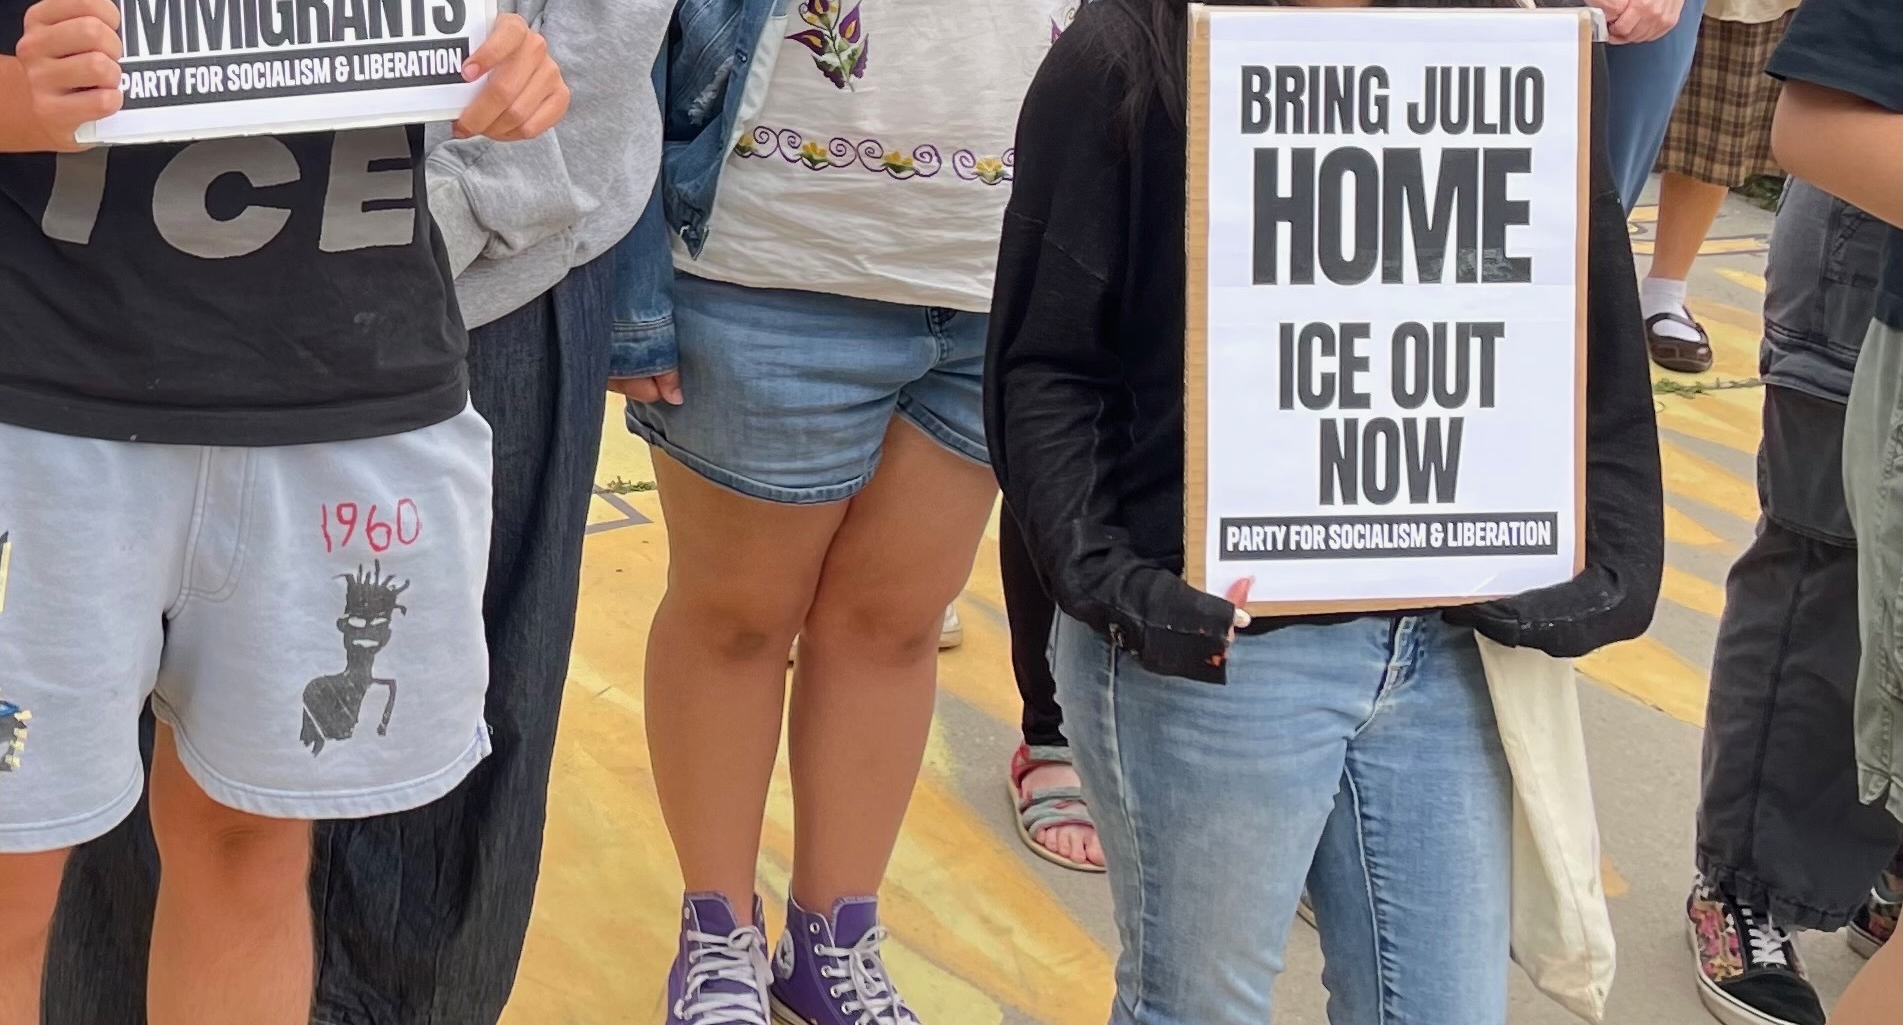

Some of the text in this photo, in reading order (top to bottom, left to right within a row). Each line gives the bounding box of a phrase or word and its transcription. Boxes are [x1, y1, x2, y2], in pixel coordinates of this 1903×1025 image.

[120, 47, 462, 99] PARTY FOR SOCIALISM & LIBERATION
[1241, 66, 1544, 135] BRING JULIO
[42, 125, 415, 259] ICE
[1253, 147, 1531, 285] HOME
[1280, 322, 1504, 410] ICE OUT
[1320, 417, 1464, 505] NOW
[321, 498, 424, 552] 1960
[1227, 520, 1552, 551] PARTY FOR SOCIALISM & LIBERATION
